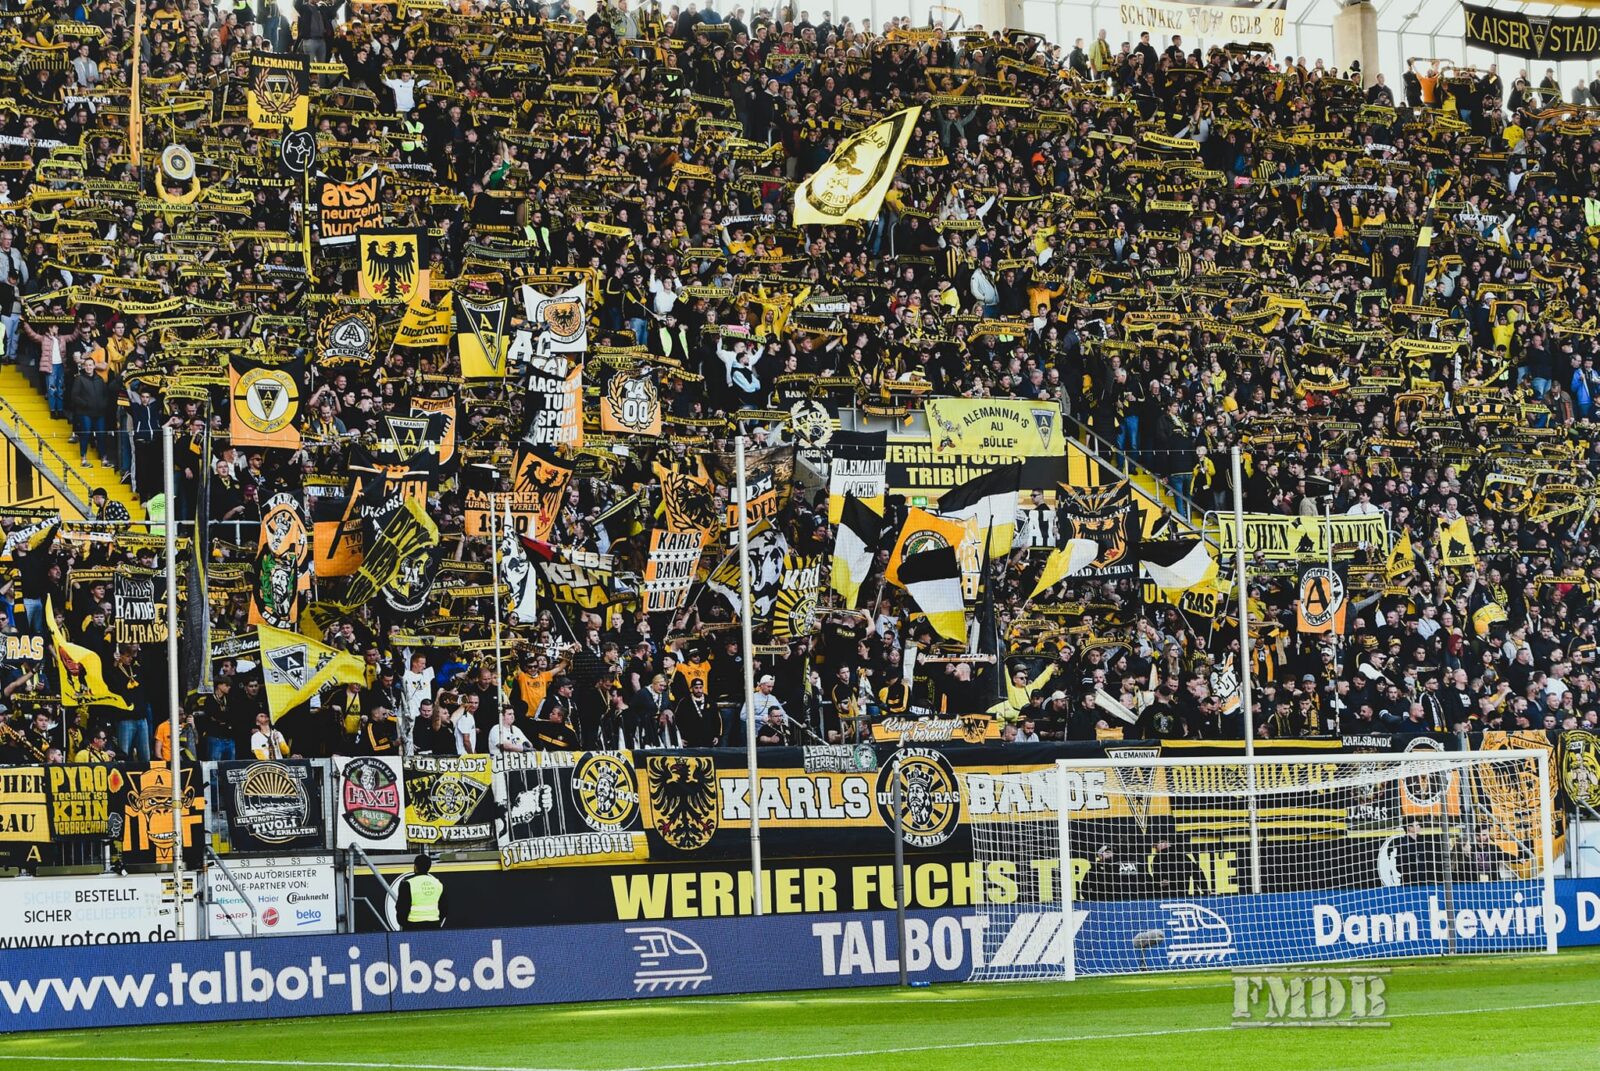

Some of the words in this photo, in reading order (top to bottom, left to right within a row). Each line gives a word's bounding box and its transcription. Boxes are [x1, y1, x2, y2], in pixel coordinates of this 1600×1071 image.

[1120, 4, 1182, 30] SCHWARZ
[1230, 15, 1262, 35] GELB
[1464, 12, 1531, 50] KAISER
[1550, 26, 1600, 53] STAD
[251, 56, 304, 71] ALEMANNIA
[273, 82, 282, 92] A
[258, 114, 294, 126] AACHEN
[262, 180, 280, 188] WILL
[322, 178, 377, 206] atsv
[321, 203, 381, 220] neunzehn
[322, 215, 384, 237] hundert
[58, 288, 74, 296] TSV
[124, 303, 162, 311] ALEMANNIA
[480, 314, 493, 329] A
[507, 330, 533, 362] A
[1400, 339, 1430, 349] ALEMANNIA
[330, 349, 368, 358] AACHEN
[264, 391, 273, 399] A
[538, 410, 577, 428] SPORT
[622, 399, 648, 424] 00
[962, 407, 1029, 429] ALEMANNIA'S
[991, 422, 1004, 432] AU
[1040, 417, 1049, 426] A
[404, 429, 417, 445] A
[536, 426, 578, 444] VEREIN
[836, 458, 886, 476] ALEMANNIA
[906, 462, 992, 487] TRIBÜ
[466, 489, 541, 505] AAHENER
[843, 482, 879, 498] AACHEN
[265, 495, 299, 511] KARLS
[0, 507, 34, 516] lemannia
[36, 507, 60, 518] Aache
[479, 513, 529, 533] 190
[658, 532, 701, 550] KARLS
[1223, 523, 1289, 551] ACHEN
[656, 560, 693, 578] BANDE
[783, 563, 820, 590] KBU
[1072, 566, 1093, 578] BAD
[1094, 563, 1133, 577] AACHEN
[1185, 590, 1214, 615] RAS
[1307, 578, 1331, 613] A
[115, 595, 155, 620] BANDE
[115, 619, 168, 644] ULTRAS
[6, 635, 44, 661] RAS
[286, 656, 300, 668] A
[918, 715, 963, 734] Sekunde
[1342, 735, 1392, 749] KARLSBANDE
[803, 745, 854, 758] LEGENDEN
[896, 748, 940, 764] KARLS
[1114, 751, 1156, 760] ALEMANNIA
[404, 757, 437, 772] FÜR
[438, 757, 488, 773] STADT
[490, 751, 539, 774] GEGEN
[541, 749, 575, 768] ALLE
[0, 774, 46, 794] HER
[49, 766, 108, 793] PYRO
[154, 775, 164, 785] A
[348, 787, 397, 807] FAXE
[572, 778, 594, 792] ULT
[616, 789, 640, 804] RAS
[720, 777, 870, 819] KARLS
[878, 792, 904, 805] UL
[934, 791, 961, 804] RAS
[967, 771, 1110, 815] BANDE
[53, 801, 109, 822] KEIN
[0, 813, 36, 833] AU
[252, 818, 297, 835] TIVOLI
[408, 825, 441, 841] UND
[441, 824, 491, 841] VEREIN
[904, 831, 948, 849] BANDE
[26, 845, 42, 862] A
[502, 832, 635, 866] STADIONVERBOTE!
[316, 856, 326, 864] S3
[233, 872, 253, 881] SIND
[254, 869, 317, 879] AUTORISIERTER
[75, 889, 139, 903] BESTELLT.
[215, 881, 286, 893] ONLE-PARTNER
[288, 881, 309, 890] VON:
[611, 867, 837, 920] WERNER
[852, 861, 1018, 911] FUCHS
[258, 895, 280, 903] Haier
[287, 892, 328, 905] Bauknecht
[24, 909, 72, 923] SICHER
[296, 909, 321, 920] beko
[1313, 904, 1418, 947] Dann
[1429, 892, 1566, 940] bewirb
[0, 924, 175, 950] www.rotcom.de
[812, 915, 990, 977] TALBOT
[0, 939, 536, 1014] www.talbot-jobs.de
